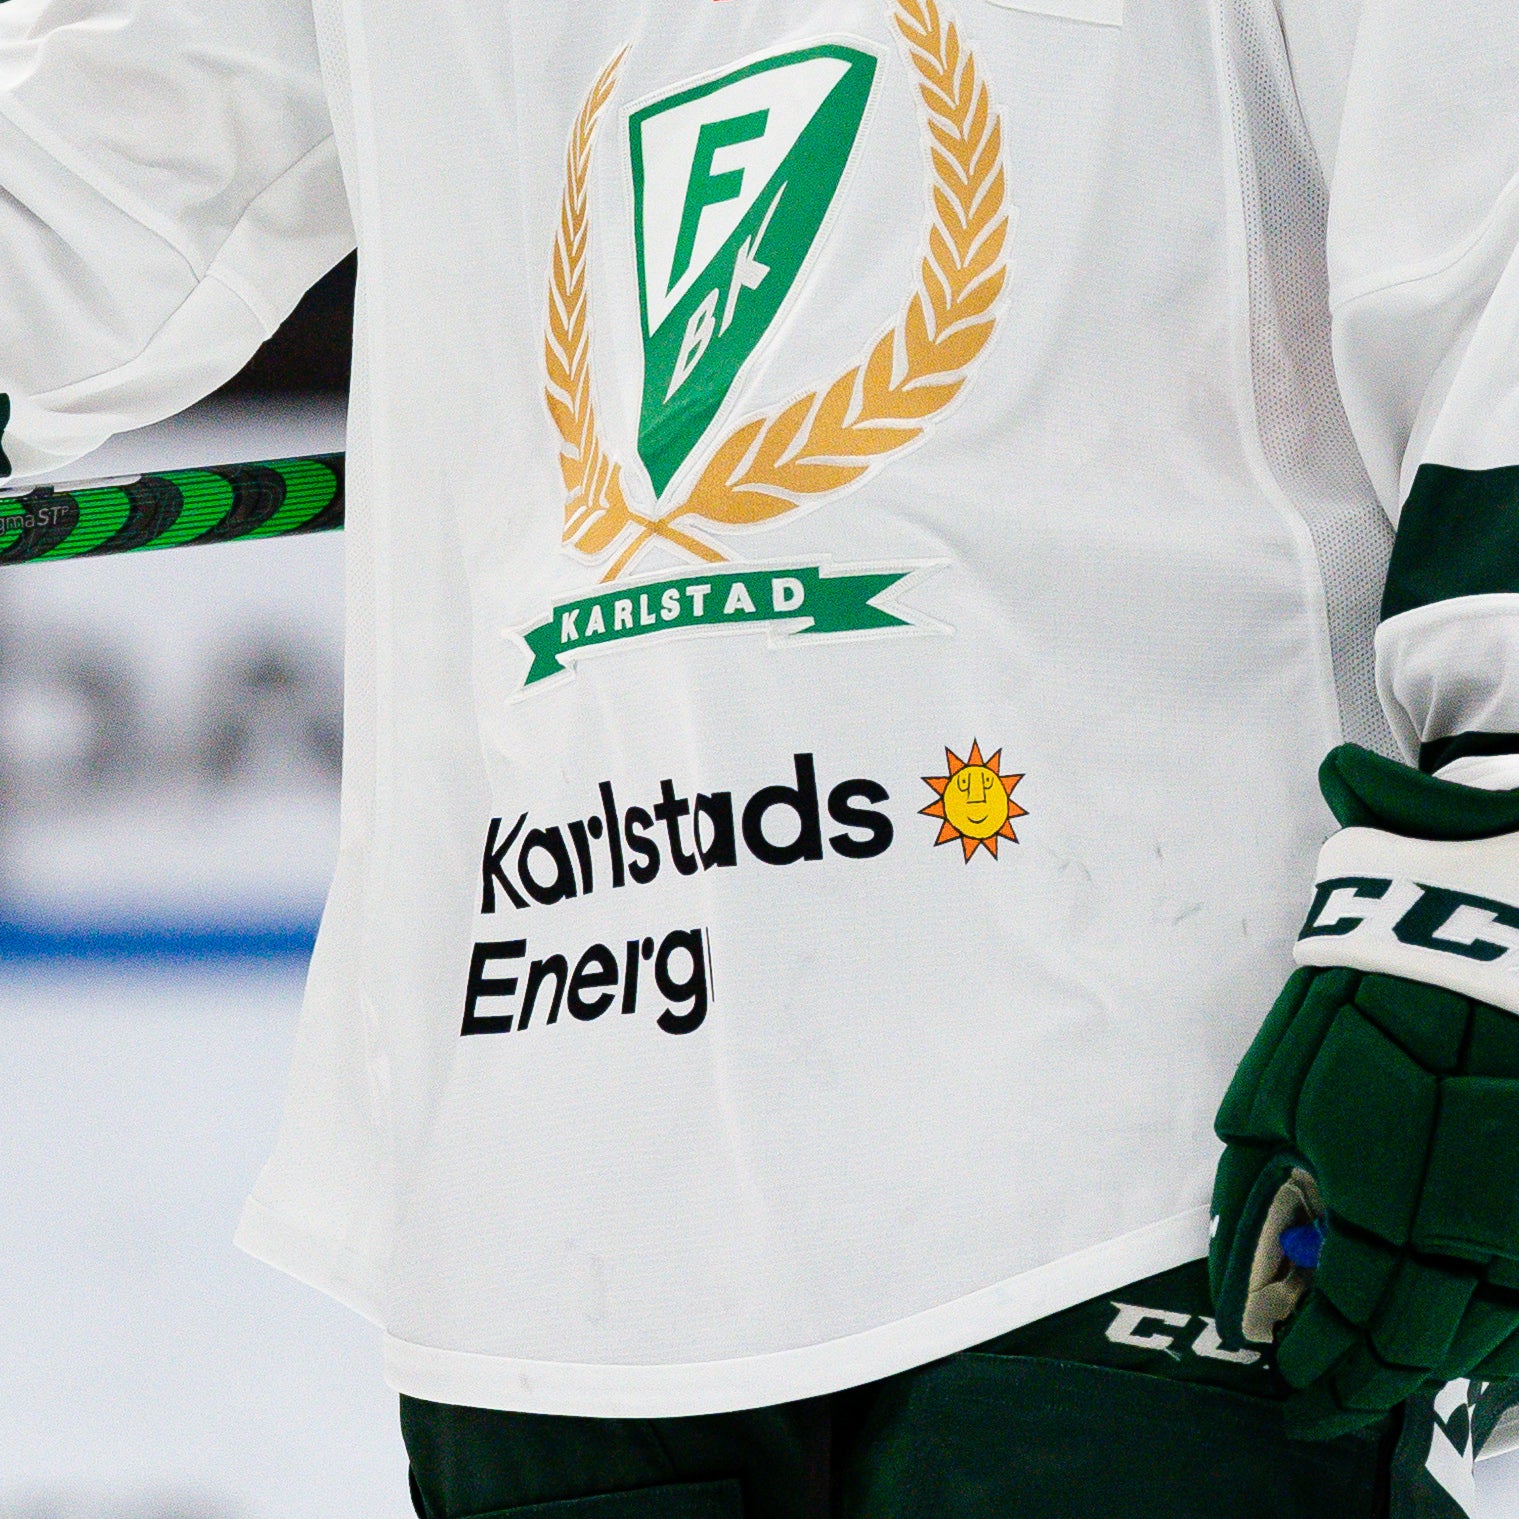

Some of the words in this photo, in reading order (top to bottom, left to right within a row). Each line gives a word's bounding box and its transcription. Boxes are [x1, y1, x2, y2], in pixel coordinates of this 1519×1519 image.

[559, 576, 807, 645] KARLSTAD
[479, 752, 895, 915] Karlstads
[459, 925, 715, 1036] Energ
[1105, 1300, 1271, 1370] CC
